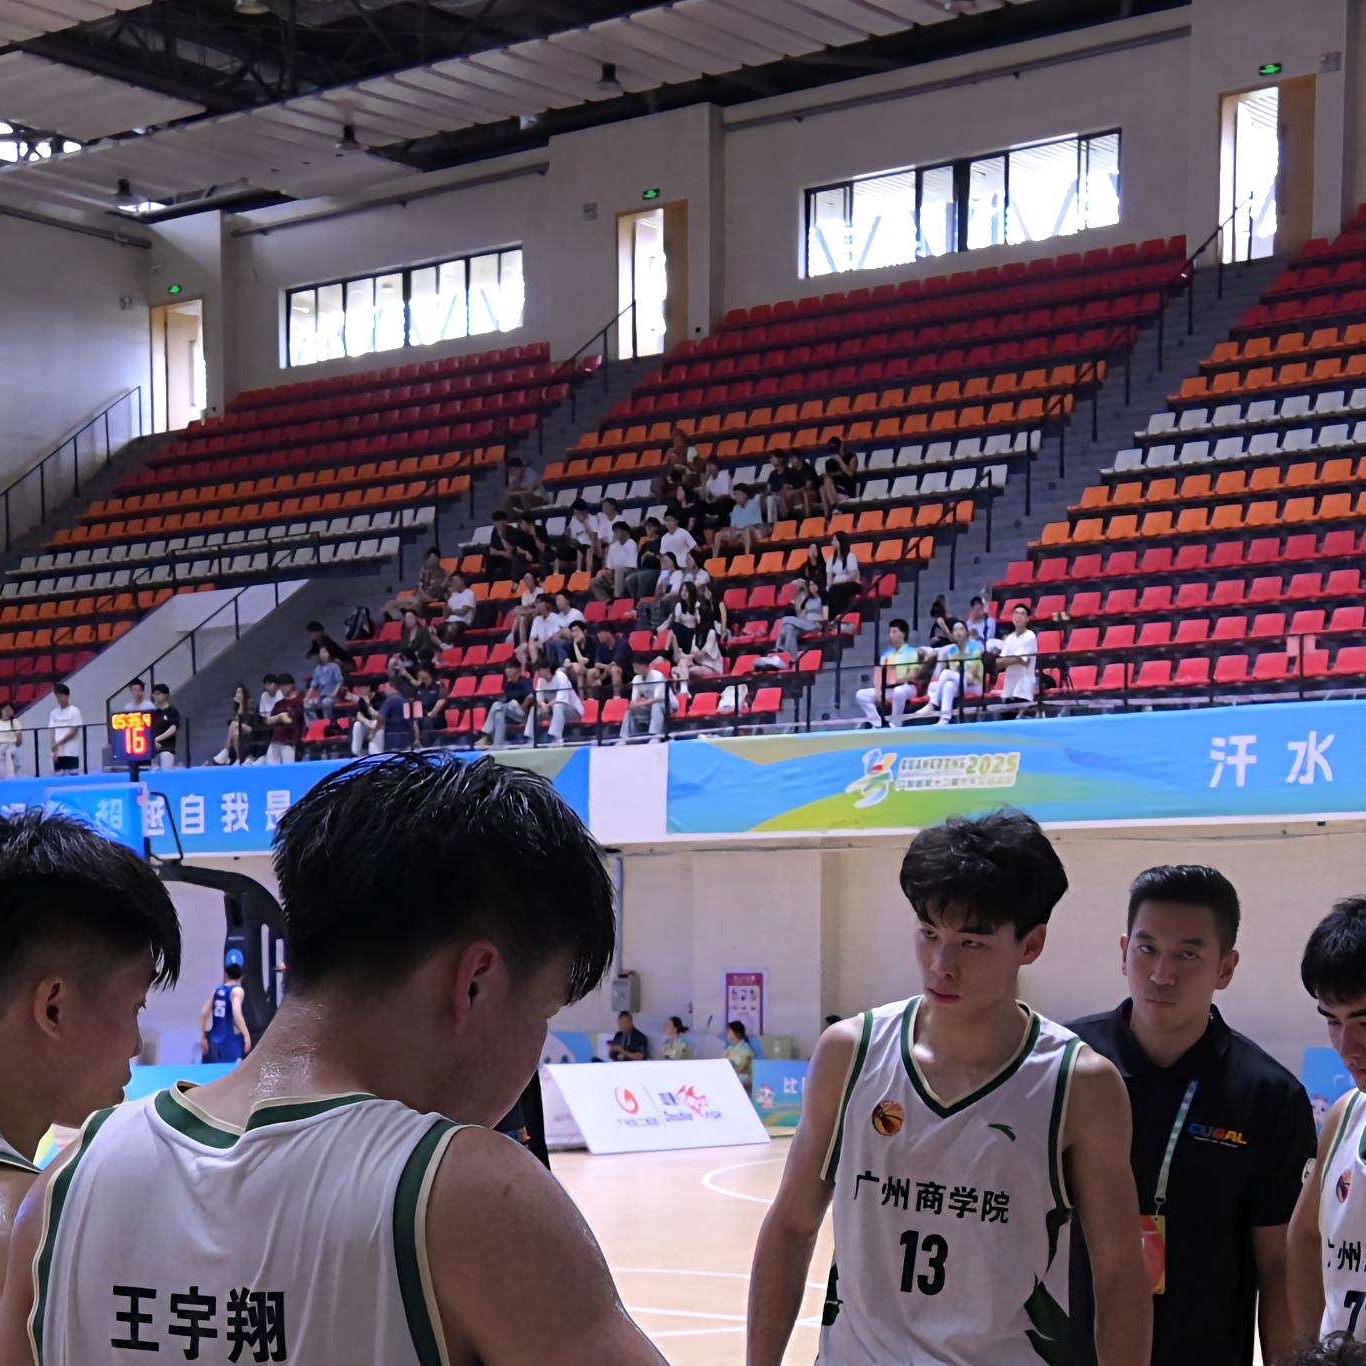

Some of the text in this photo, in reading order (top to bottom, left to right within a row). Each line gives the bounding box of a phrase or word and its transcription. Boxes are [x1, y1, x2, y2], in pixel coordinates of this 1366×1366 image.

[125, 727, 145, 754] 16
[965, 753, 1019, 775] 2025
[854, 1170, 1011, 1225] 广州商学院
[899, 1229, 949, 1296] 13
[110, 1285, 288, 1364] 王宇翔
